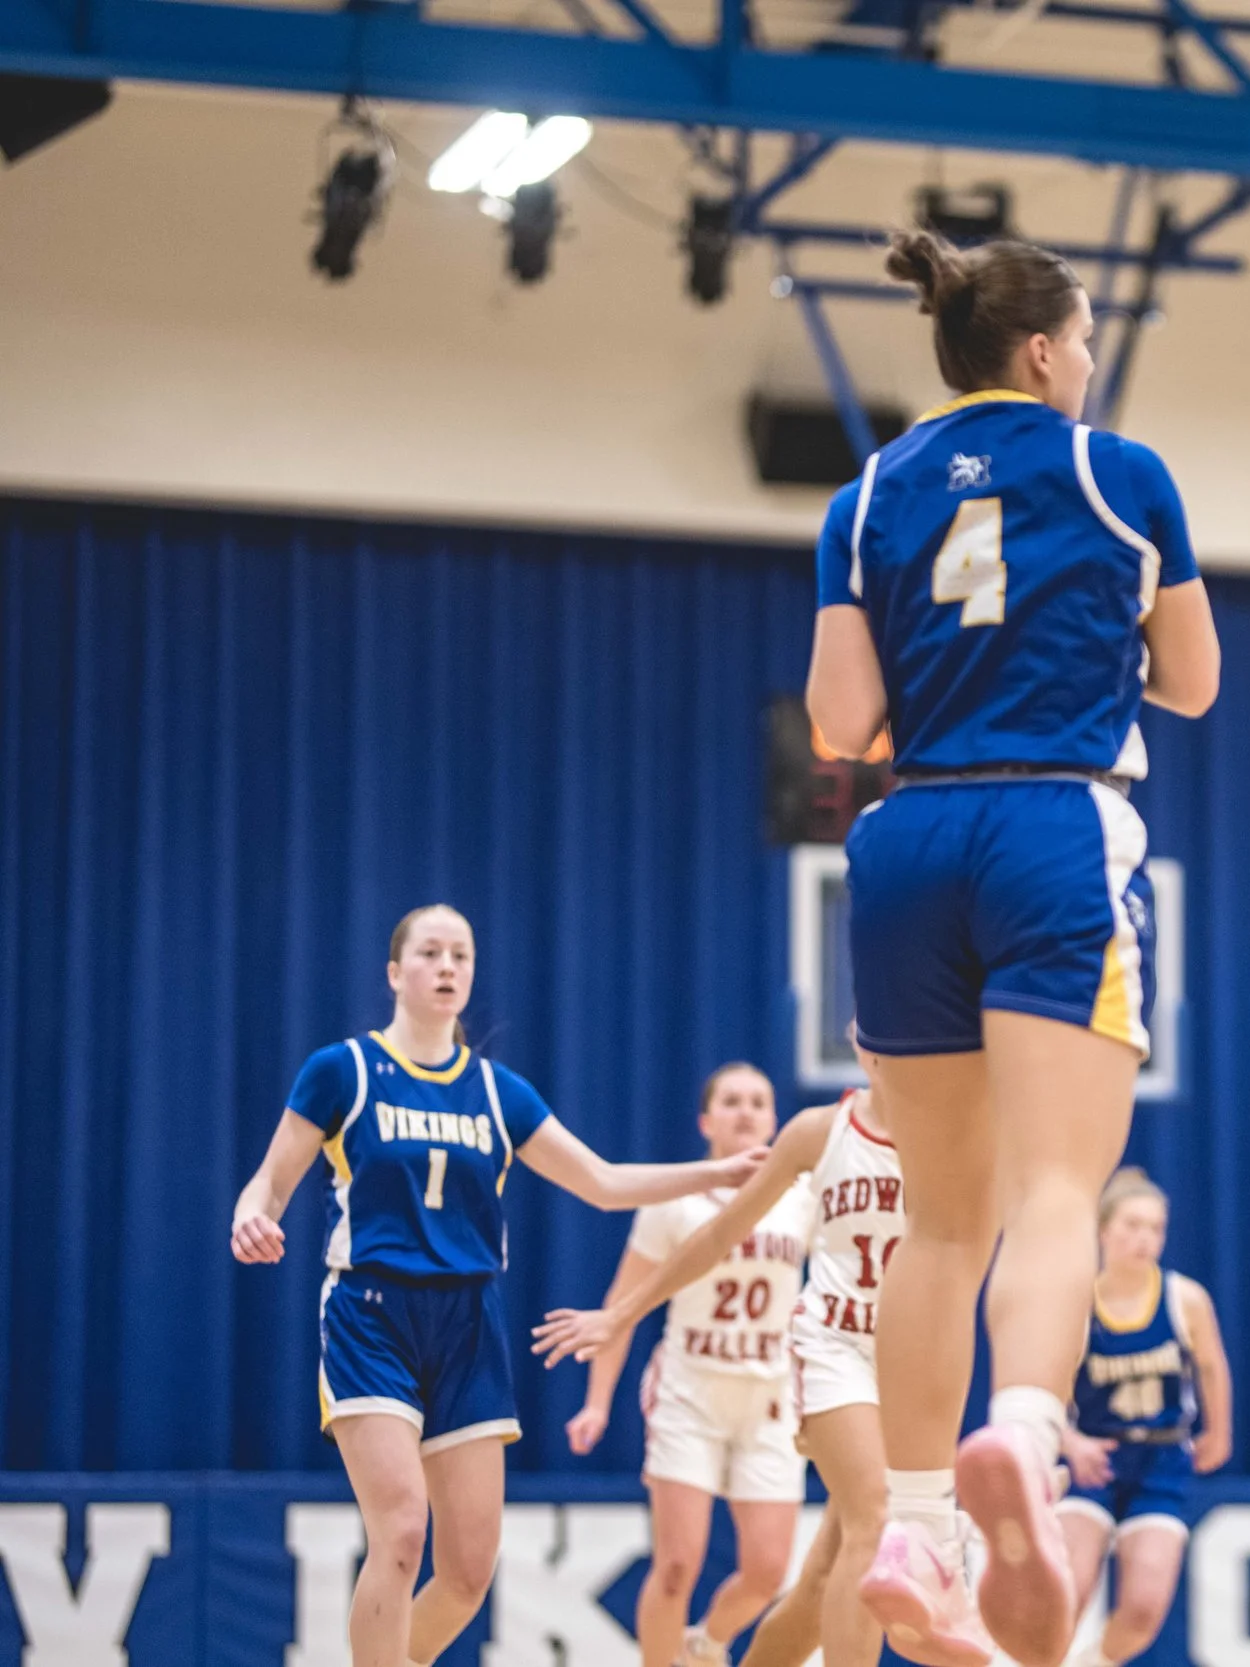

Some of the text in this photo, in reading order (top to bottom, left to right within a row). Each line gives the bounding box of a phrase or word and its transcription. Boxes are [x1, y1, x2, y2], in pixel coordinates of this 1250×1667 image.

[931, 496, 1008, 628] 4
[375, 1100, 493, 1155] VIKINGS
[424, 1147, 449, 1210] 1
[822, 1176, 906, 1224] REDW
[712, 1277, 771, 1321] 20
